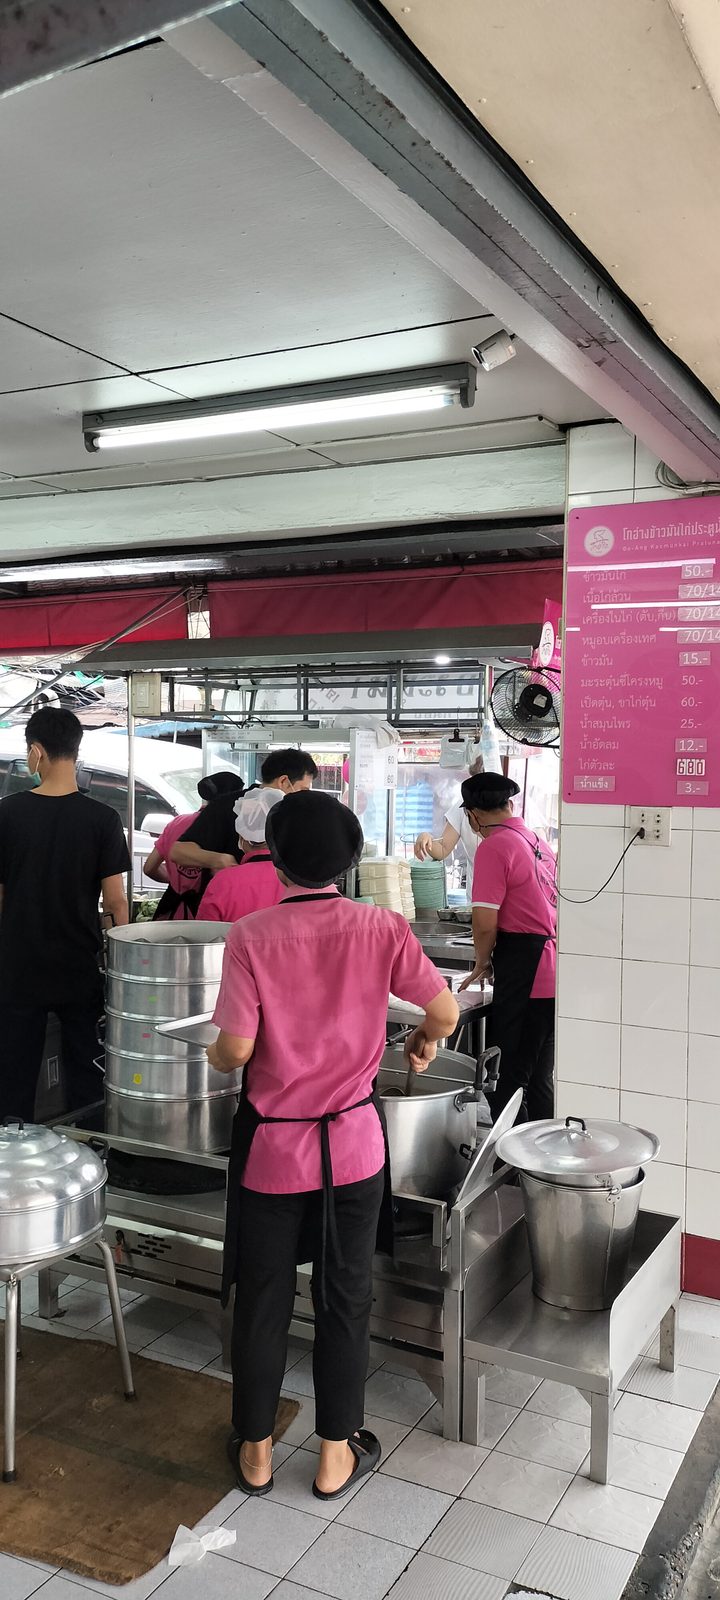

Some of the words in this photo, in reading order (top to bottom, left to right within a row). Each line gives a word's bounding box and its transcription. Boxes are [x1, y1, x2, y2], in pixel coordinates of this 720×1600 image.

[684, 565, 713, 577] 50.-
[582, 629, 657, 649] หมูอบเครื่องเทศ
[581, 653, 614, 667] ข้าวมัน
[683, 653, 708, 665] 15.-
[681, 675, 704, 686] 50.-
[680, 697, 703, 707] 60.-
[579, 714, 631, 732] น้ำสมุนไพร
[680, 719, 702, 729] 25.-
[579, 734, 620, 750] น้ำอัดลม
[679, 740, 704, 751] 12.-
[578, 757, 615, 771] ไก่ตัวละ
[580, 776, 609, 789] น้ำแข็ง
[685, 783, 701, 793] 3.-
